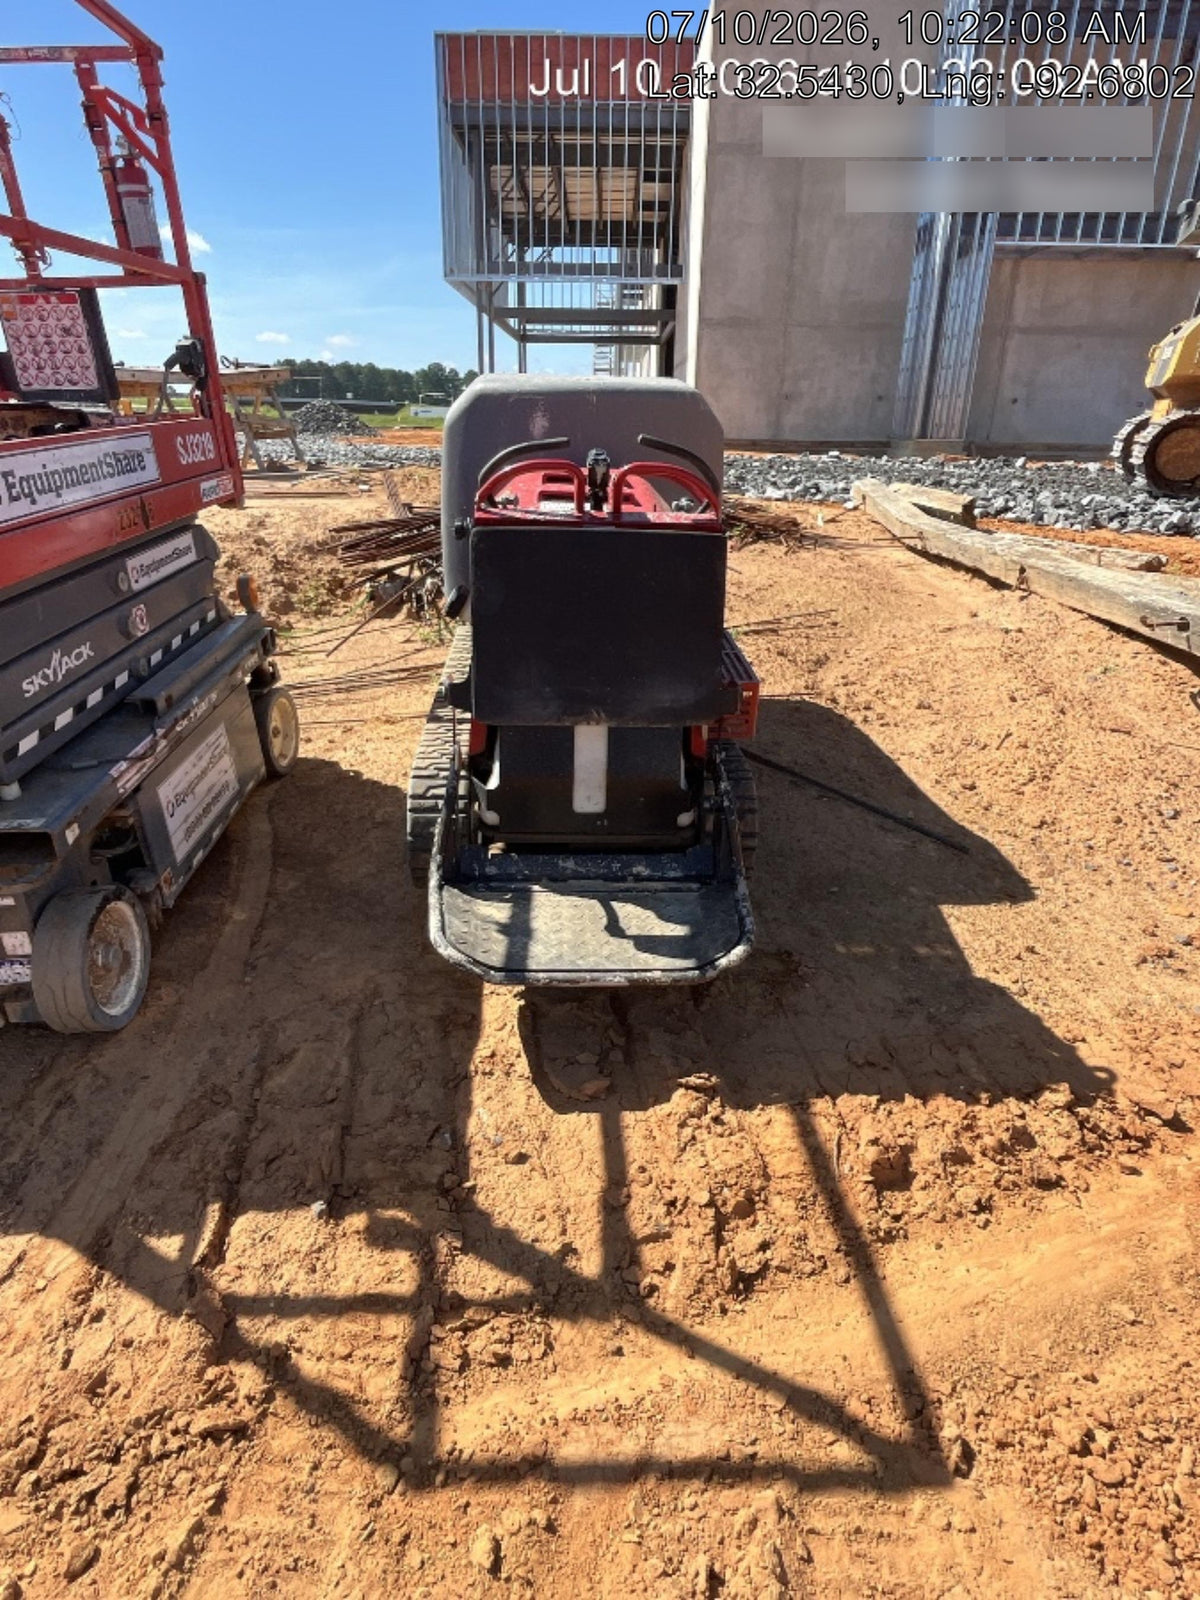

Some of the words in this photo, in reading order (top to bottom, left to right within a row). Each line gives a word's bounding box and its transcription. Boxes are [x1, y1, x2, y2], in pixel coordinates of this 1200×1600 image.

[177, 431, 216, 465] SJ3219
[2, 451, 147, 505] EquipmentShare
[22, 641, 95, 698] SKYJACK
